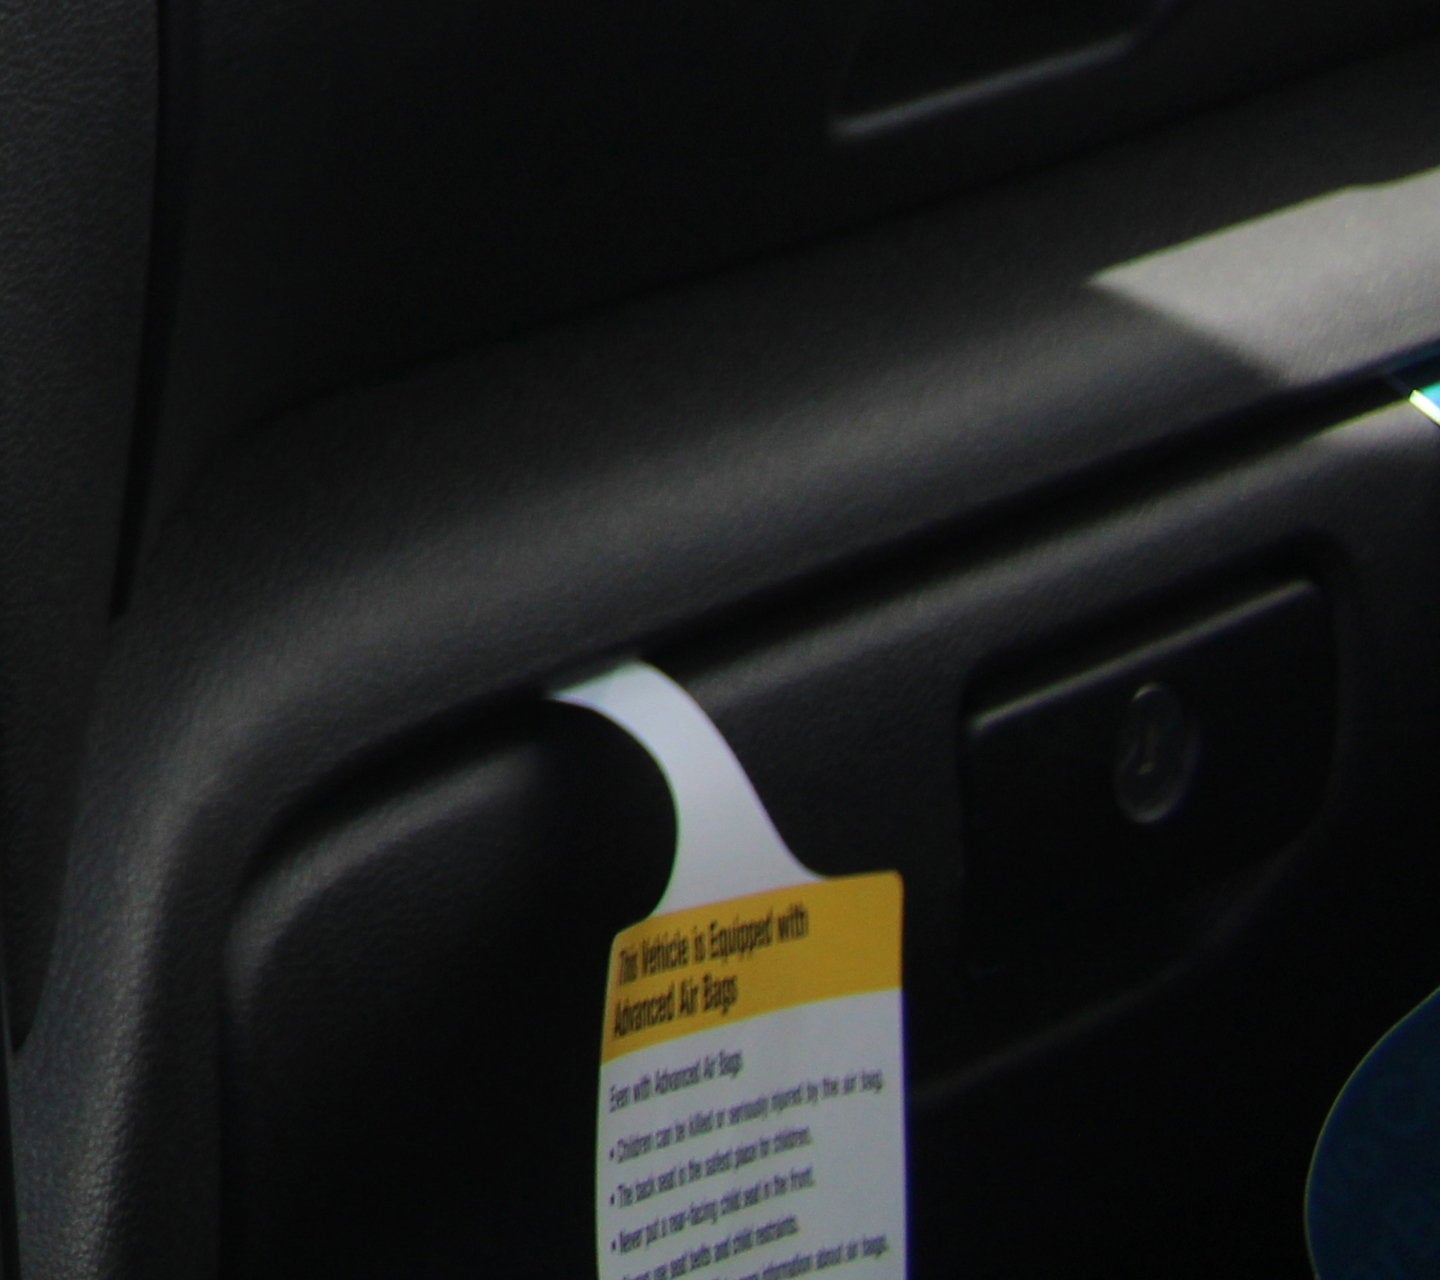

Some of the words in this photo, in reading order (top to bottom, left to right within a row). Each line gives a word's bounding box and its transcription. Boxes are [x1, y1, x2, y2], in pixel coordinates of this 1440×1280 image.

[618, 948, 638, 985] This
[641, 931, 690, 976] Vehicle
[693, 926, 706, 962] is
[710, 906, 773, 963] Equipped
[777, 901, 809, 940] with
[614, 983, 676, 1037] Advanced
[679, 975, 699, 1016] Air
[703, 972, 739, 1015] Bags
[633, 1074, 651, 1102] with
[655, 1061, 700, 1094] Advanced
[703, 1054, 716, 1080] Air
[616, 1132, 652, 1163] Children
[655, 1127, 672, 1149] can
[675, 1121, 686, 1142] be
[688, 1109, 713, 1136] killed
[728, 1095, 769, 1124] seriously
[806, 1079, 819, 1104] by
[822, 1076, 839, 1098] the
[842, 1073, 858, 1095] air
[617, 1182, 633, 1208] The
[635, 1176, 655, 1203] back
[657, 1166, 677, 1197] seat
[688, 1158, 702, 1181] the
[619, 1227, 644, 1255] Never
[645, 1217, 661, 1245] put
[773, 1173, 788, 1197] the
